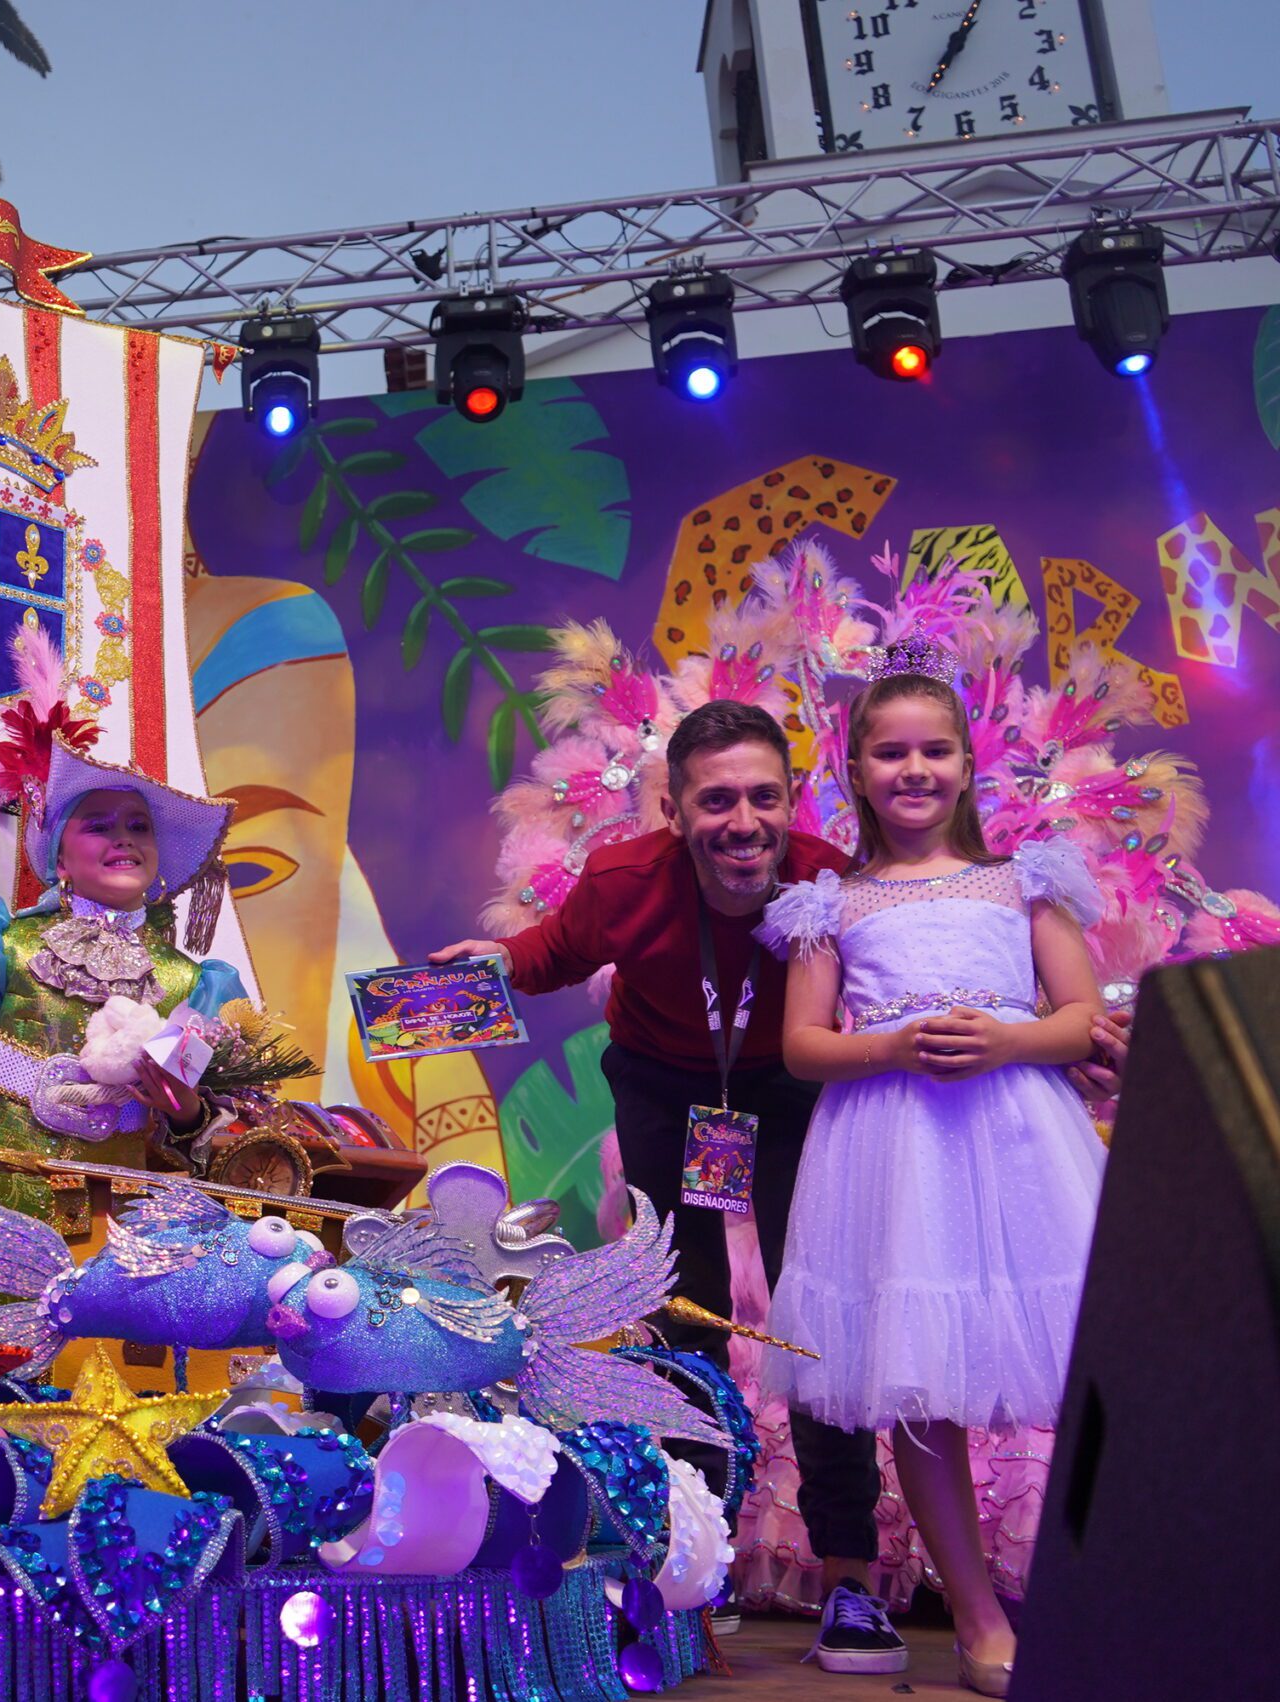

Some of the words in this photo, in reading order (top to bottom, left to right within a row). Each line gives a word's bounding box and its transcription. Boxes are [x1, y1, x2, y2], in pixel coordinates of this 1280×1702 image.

[1017, 0, 1037, 19] 2
[852, 13, 890, 40] 10
[1034, 29, 1056, 54] 3
[854, 50, 874, 75] 9
[1028, 65, 1050, 91] 4
[872, 83, 892, 109] 8
[999, 94, 1020, 121] 5
[907, 106, 926, 131] 7
[954, 110, 975, 137] 6
[683, 1191, 749, 1214] DISEÑADORES
